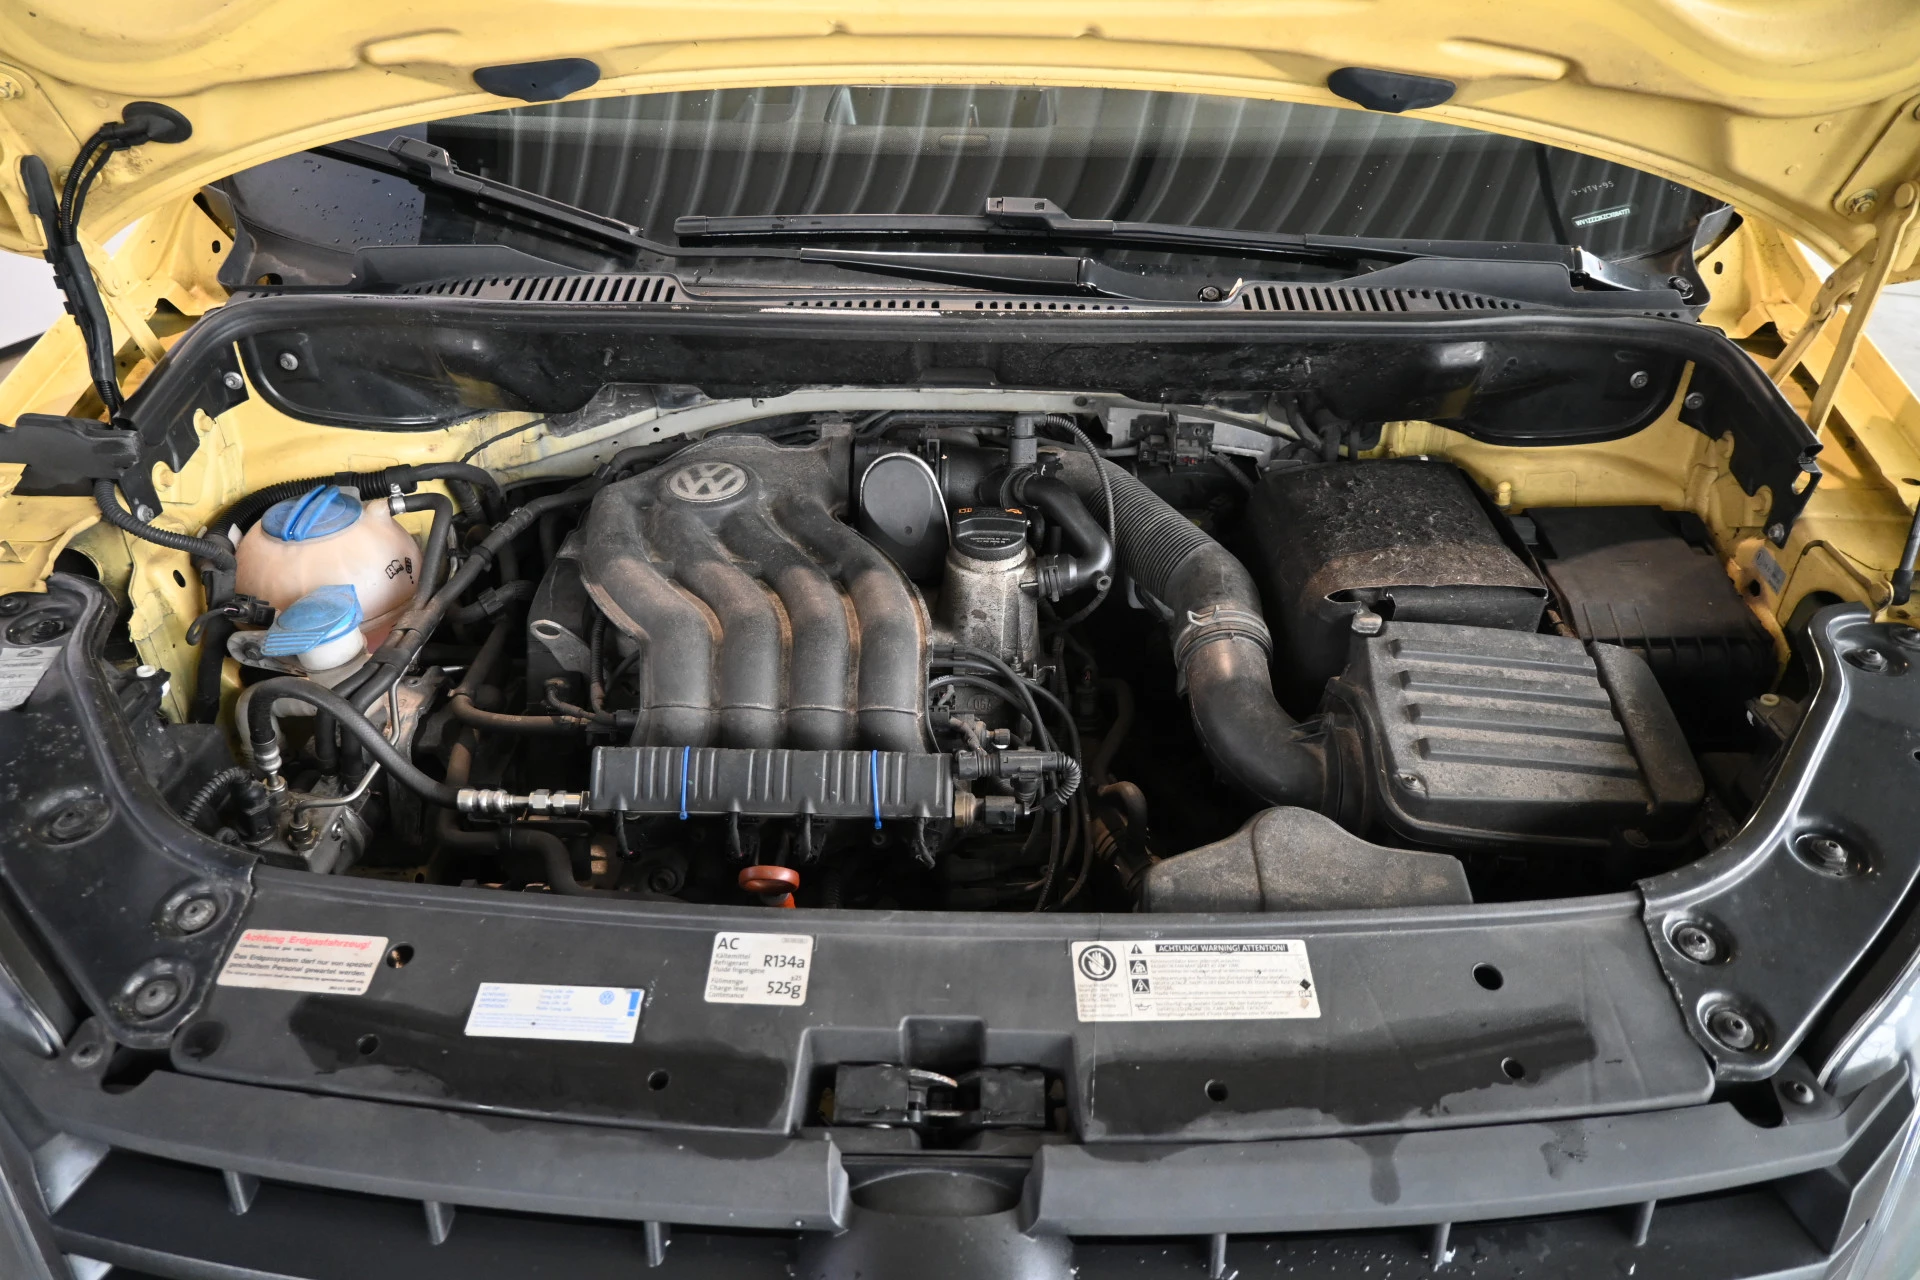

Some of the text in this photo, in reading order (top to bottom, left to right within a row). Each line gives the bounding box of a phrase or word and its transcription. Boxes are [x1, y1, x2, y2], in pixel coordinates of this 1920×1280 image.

[243, 933, 372, 951] Achtung Erdgasfahrzeug!
[717, 937, 740, 950] AC
[1200, 944, 1240, 952] WARNING!
[1242, 944, 1286, 952] ATTENTION!
[763, 954, 805, 969] R134a
[271, 964, 303, 972] Personal
[711, 977, 744, 986] Füllmenge
[709, 984, 731, 992] Charge
[766, 981, 801, 999] 525g
